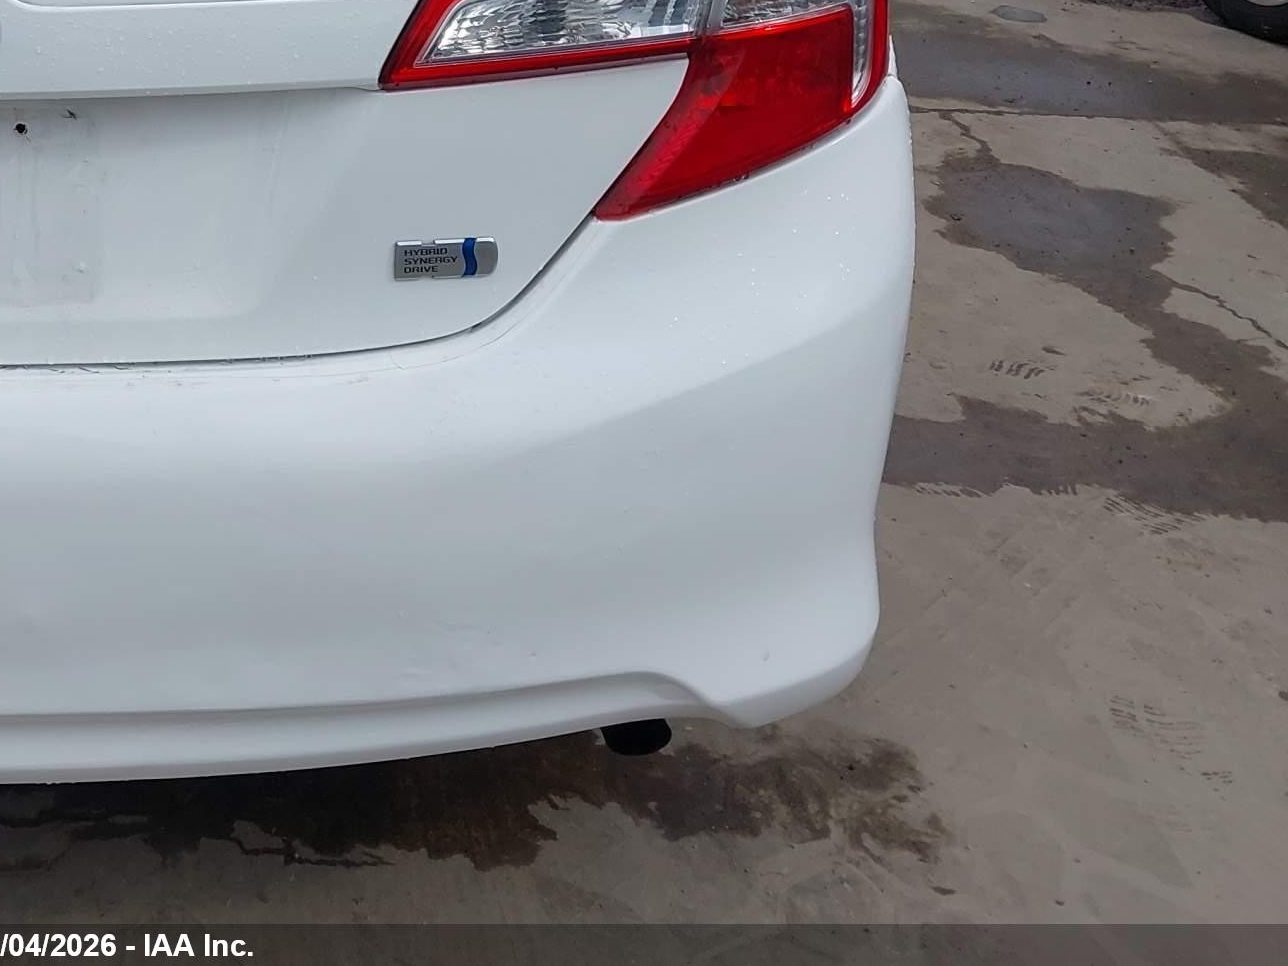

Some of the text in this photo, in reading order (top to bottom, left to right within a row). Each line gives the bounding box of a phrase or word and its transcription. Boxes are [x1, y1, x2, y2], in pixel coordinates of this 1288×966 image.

[403, 247, 448, 257] HYBRID
[403, 255, 458, 266] SYNERGY
[403, 265, 439, 274] DRIVE
